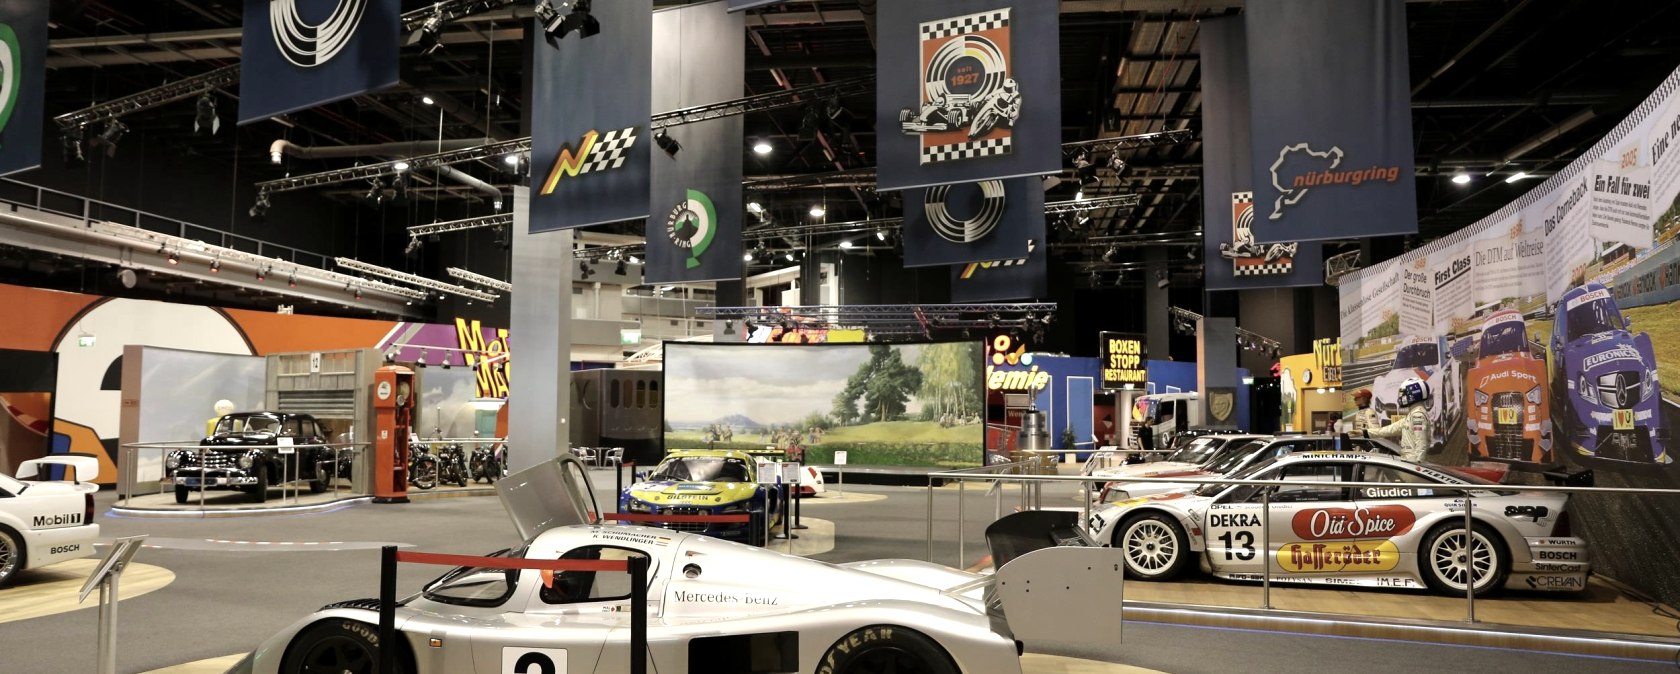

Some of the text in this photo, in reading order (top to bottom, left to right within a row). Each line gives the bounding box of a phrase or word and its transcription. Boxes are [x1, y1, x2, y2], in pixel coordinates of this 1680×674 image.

[950, 73, 980, 86] 1927
[1652, 132, 1669, 166] Eine
[1293, 166, 1399, 187] nürburgring
[1594, 174, 1651, 200] Ein Fall für zwei
[1544, 217, 1556, 237] Das
[1556, 178, 1589, 223] Comeback
[1475, 239, 1544, 267] Die DTM auf Weltreise
[1403, 269, 1427, 285] Der große
[1434, 255, 1471, 285] First Class
[1403, 283, 1431, 298] Durchbruch
[1580, 290, 1605, 303] BOSCH
[1495, 314, 1517, 323] BOSCH
[1109, 339, 1141, 355] BOXEN
[1110, 354, 1140, 369] STOPP
[1585, 349, 1639, 367] EURONICS
[1104, 368, 1146, 382] RESTAURANT
[1490, 370, 1537, 384] Audi Sport
[1366, 487, 1412, 498] Giudici
[33, 514, 69, 527] Mobil
[1210, 513, 1262, 528] DEKRA
[1309, 507, 1396, 538] Old Spice
[602, 534, 655, 545] WENDLINGER
[1217, 530, 1256, 561] 13
[50, 544, 80, 555] BOSCH
[1539, 550, 1577, 561] BOSCH
[1535, 562, 1581, 572] SinterCast
[1536, 575, 1582, 588] CREVAN
